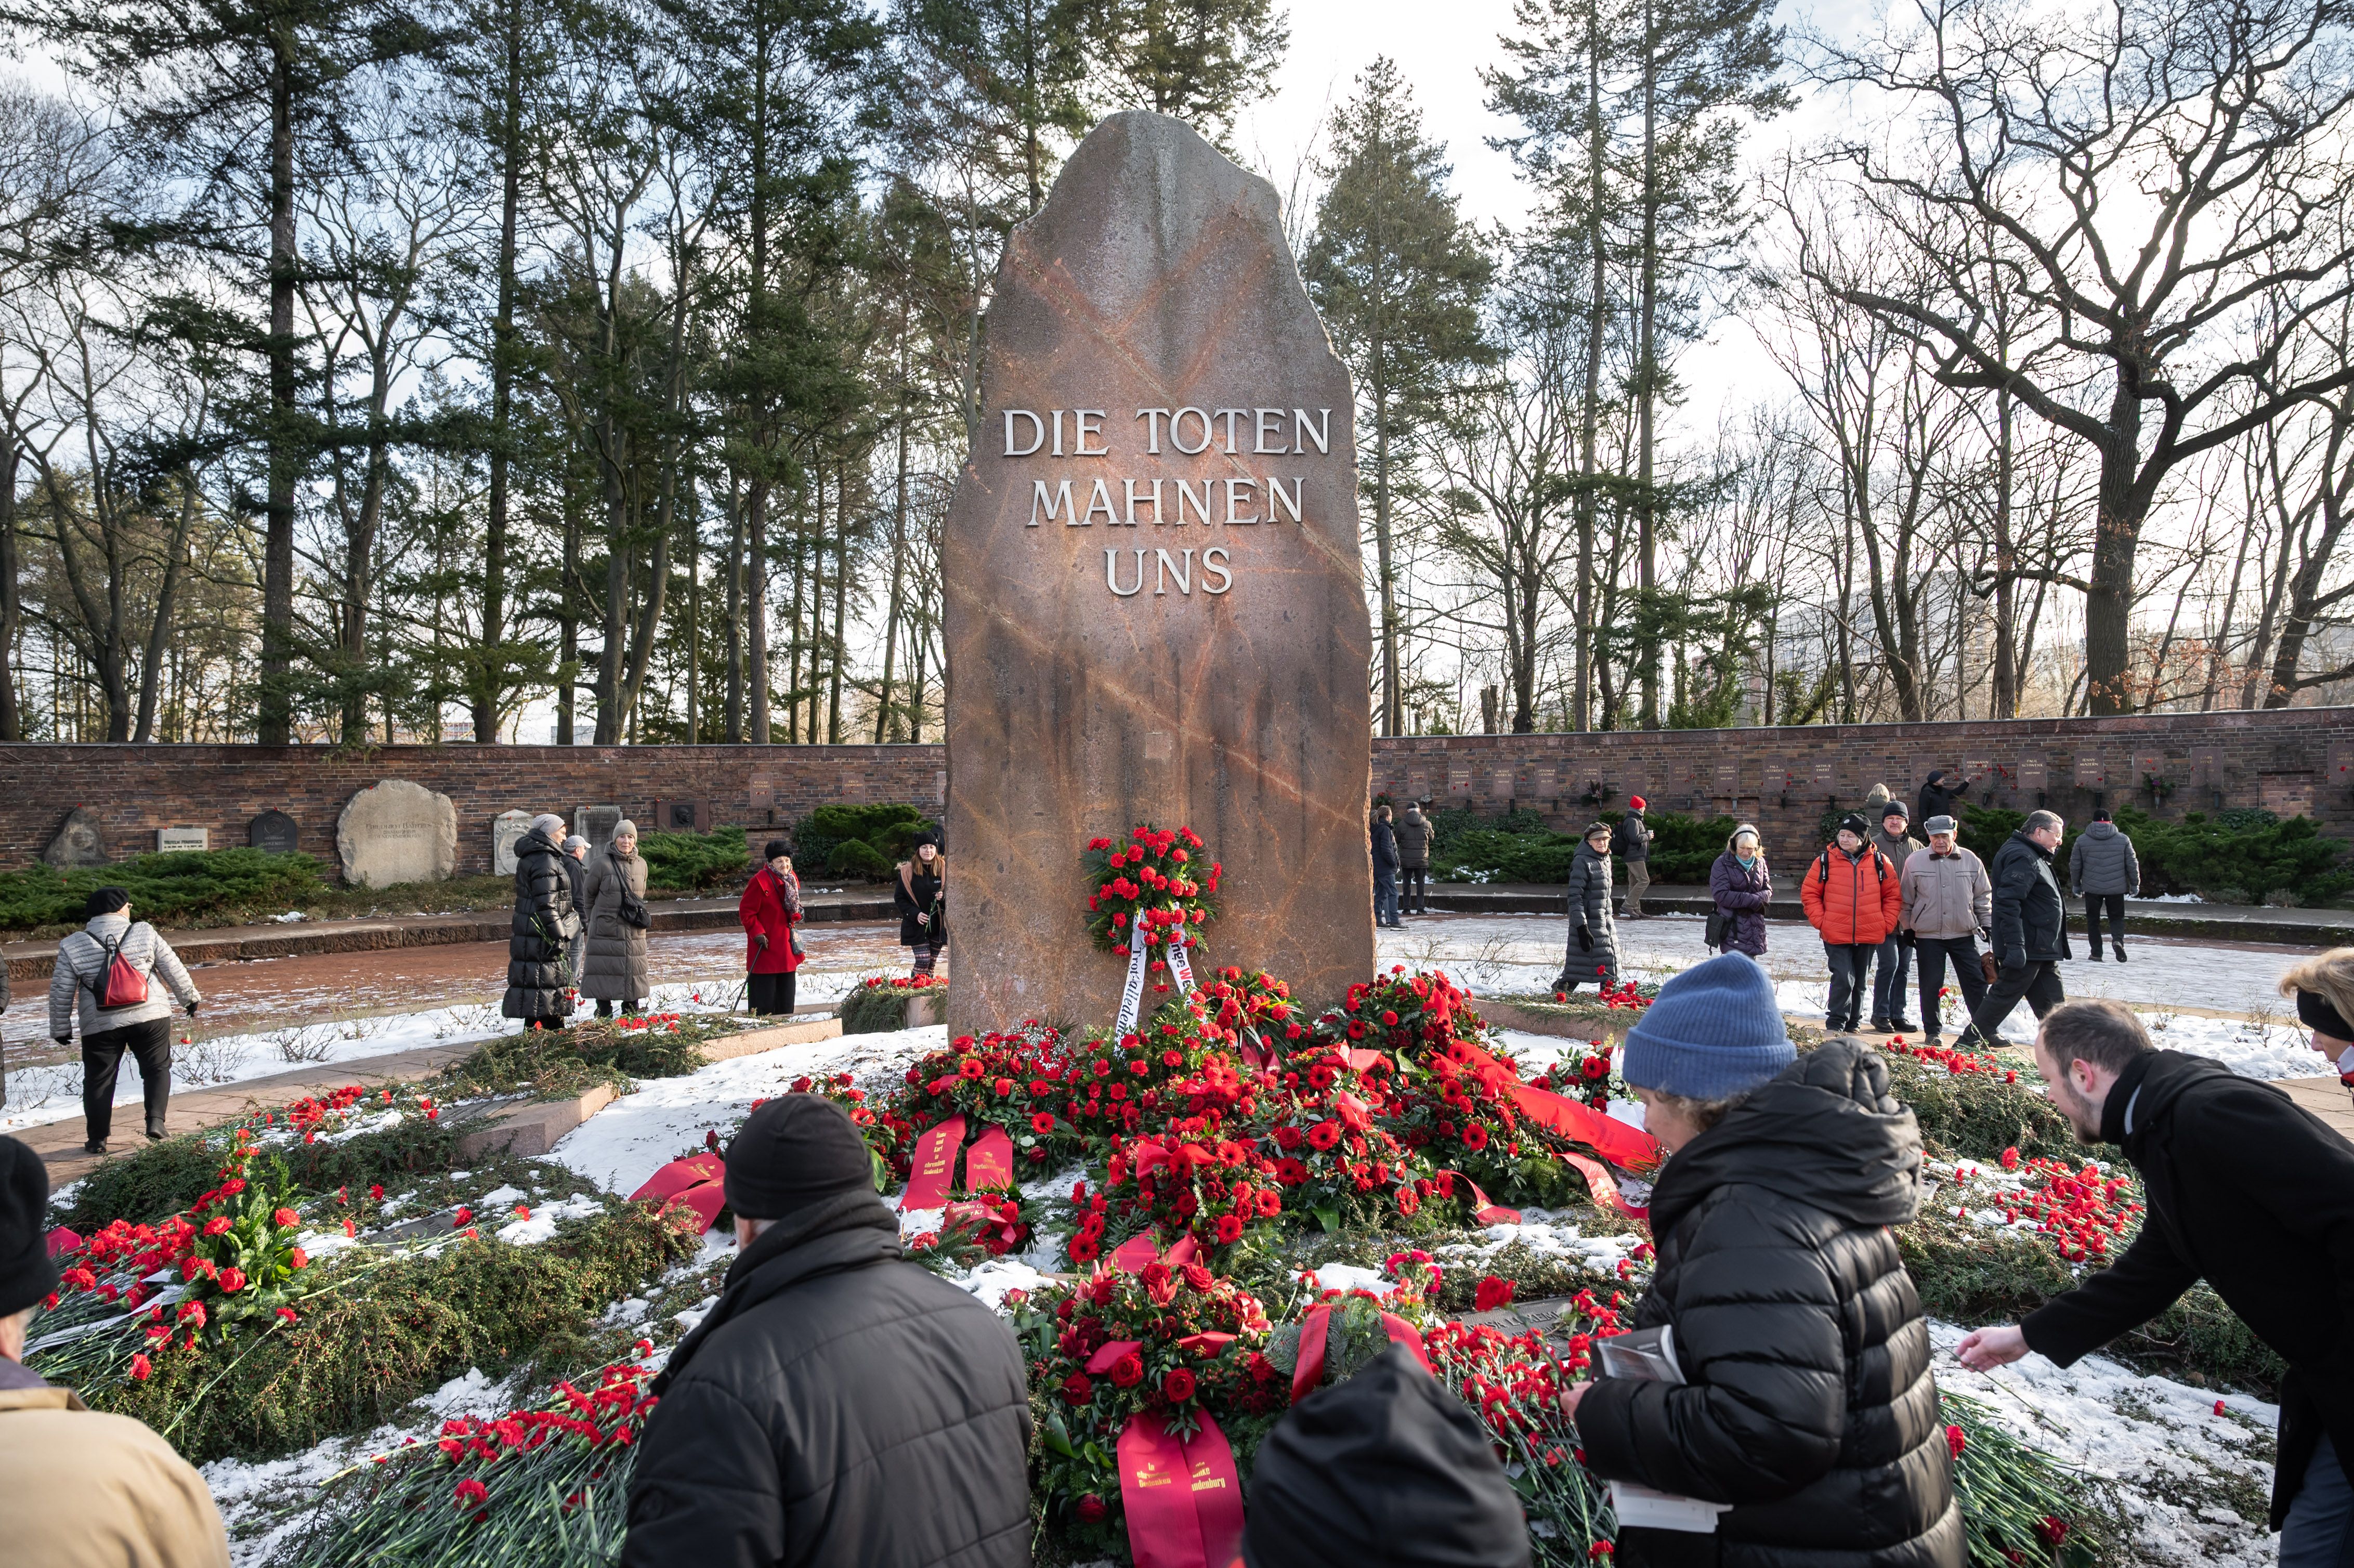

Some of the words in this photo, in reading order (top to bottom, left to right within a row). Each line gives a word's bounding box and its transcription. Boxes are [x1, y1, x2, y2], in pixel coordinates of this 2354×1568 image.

[1001, 409, 1110, 456] DIE
[1135, 406, 1332, 455] TOTEN
[1027, 477, 1305, 526] MAHNEN
[1105, 546, 1233, 596] UNS
